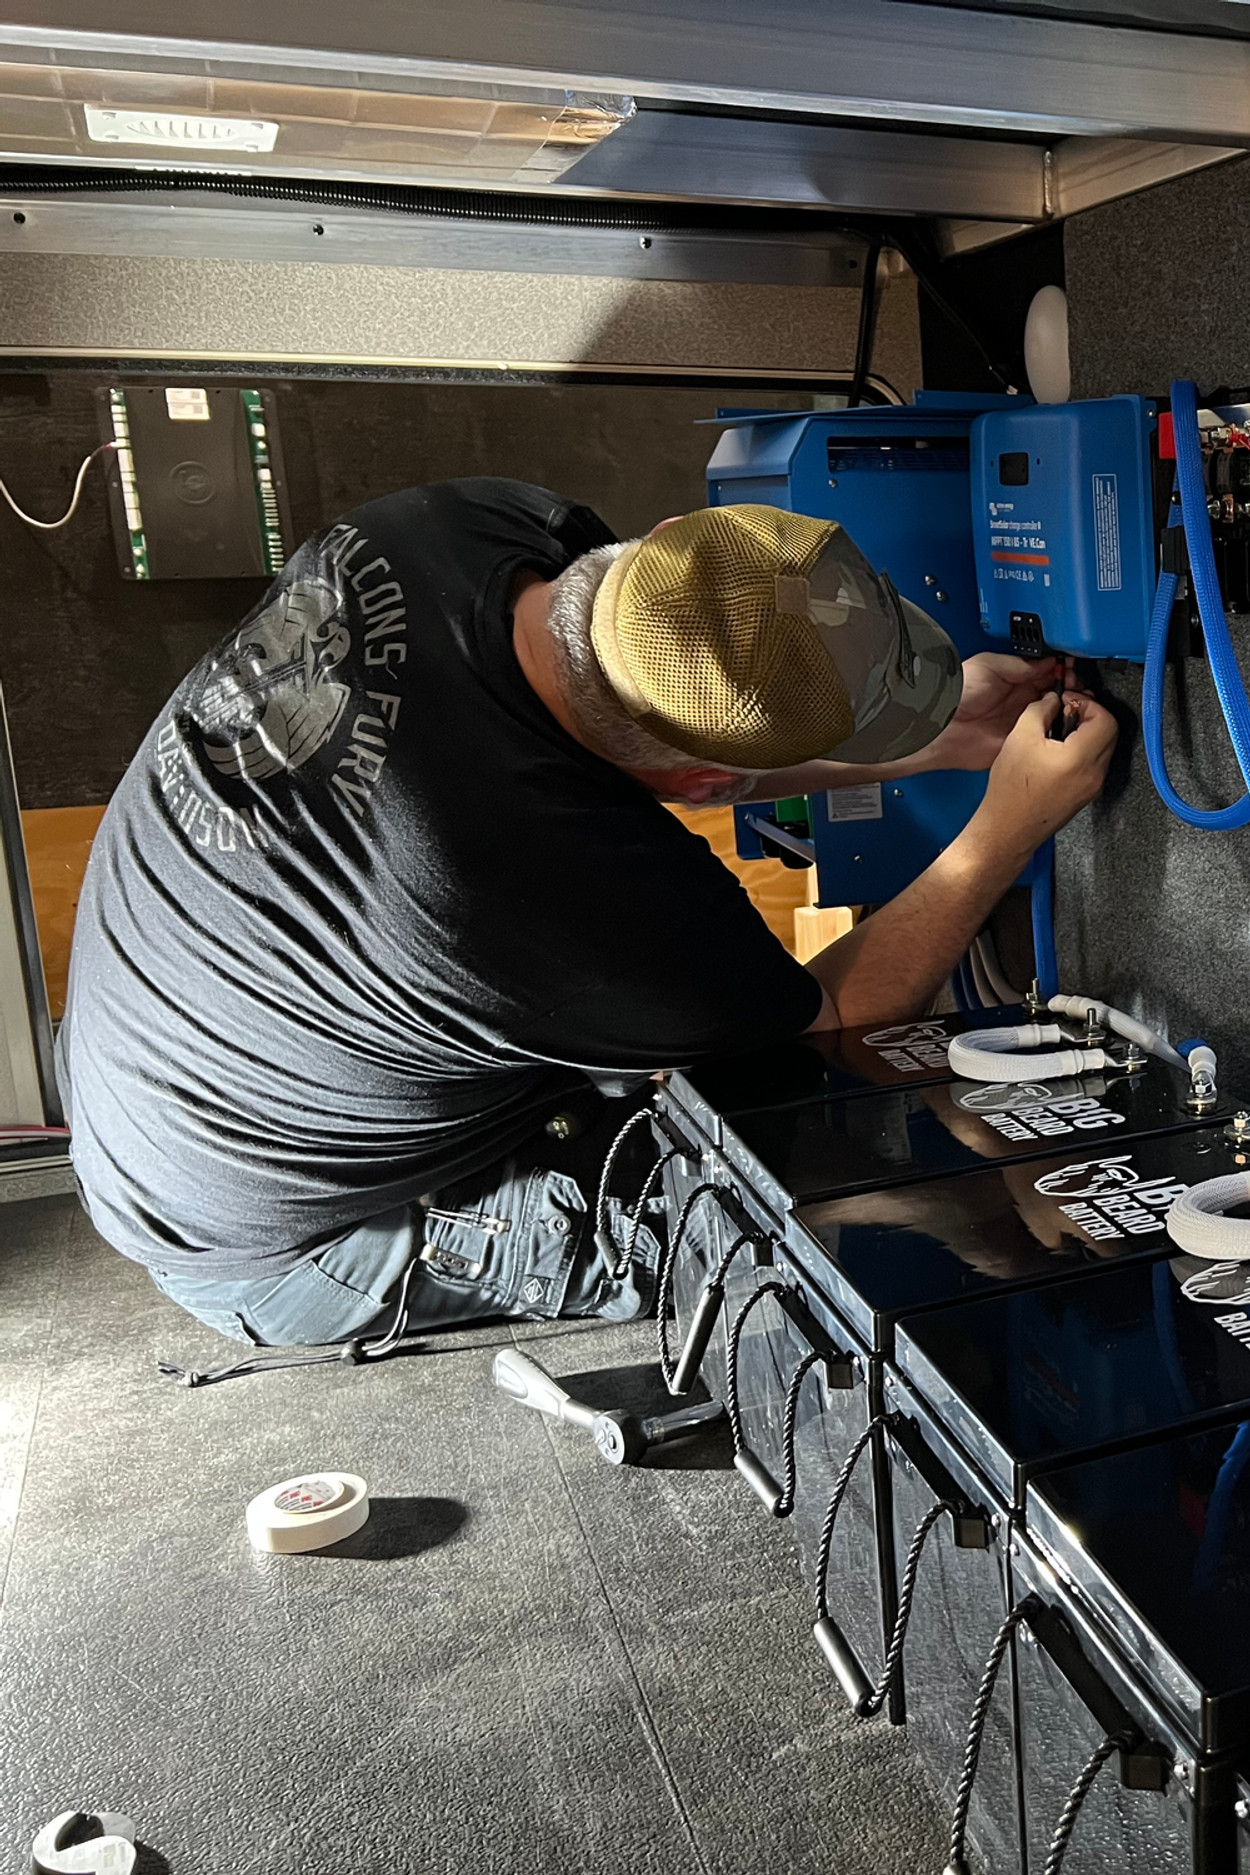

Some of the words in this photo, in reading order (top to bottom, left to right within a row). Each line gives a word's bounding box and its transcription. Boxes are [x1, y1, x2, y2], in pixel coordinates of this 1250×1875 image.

[331, 690, 402, 817] FURY
[980, 1112, 1039, 1141] BATTERY
[1011, 1106, 1075, 1136] BEARD
[1047, 1097, 1126, 1129] BIG
[1058, 1201, 1125, 1241] BATTERY
[1093, 1194, 1166, 1235] BEARD
